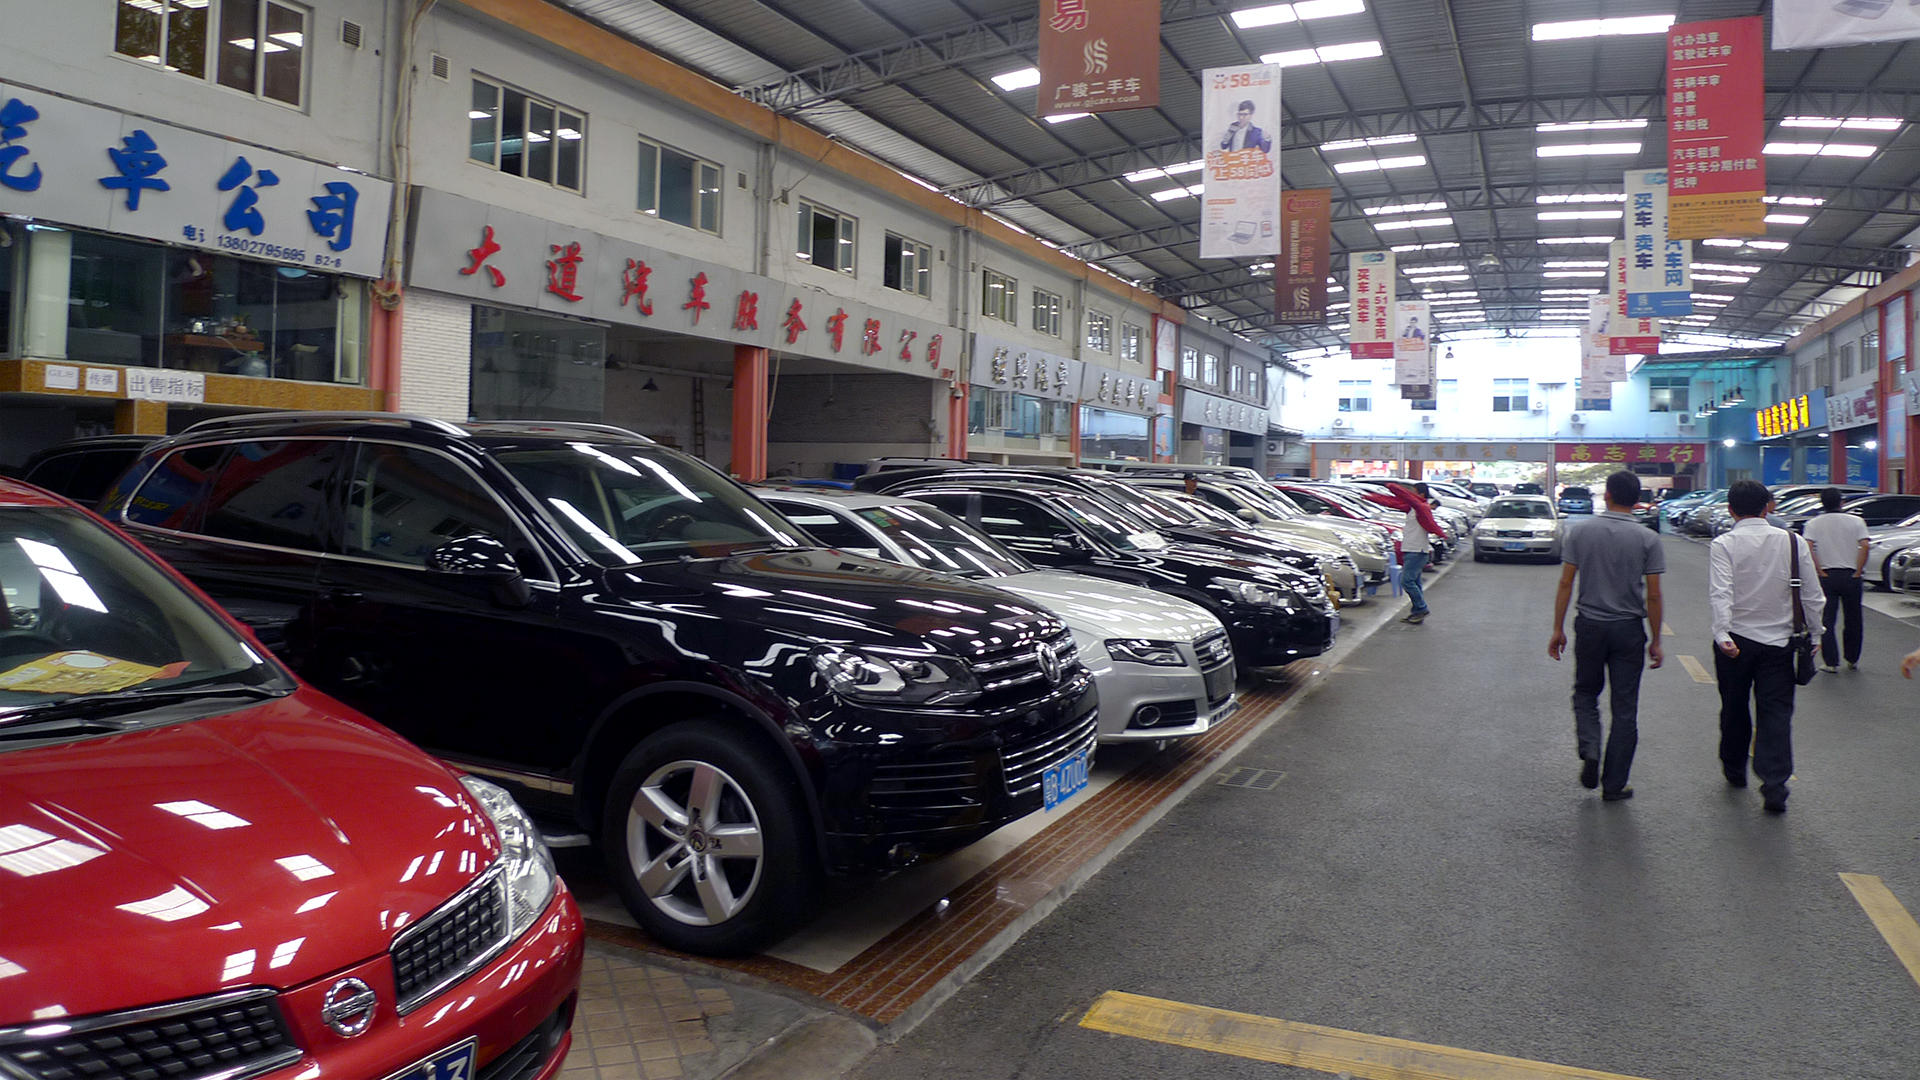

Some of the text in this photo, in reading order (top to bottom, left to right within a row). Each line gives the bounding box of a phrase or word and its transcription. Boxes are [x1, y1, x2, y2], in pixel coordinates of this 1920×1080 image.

[1054, 77, 1140, 100] 广骏二手车
[1673, 146, 1720, 159] 汽车租赁
[1673, 158, 1758, 174] 二手车分期付款
[130, 375, 203, 397] 出售指标
